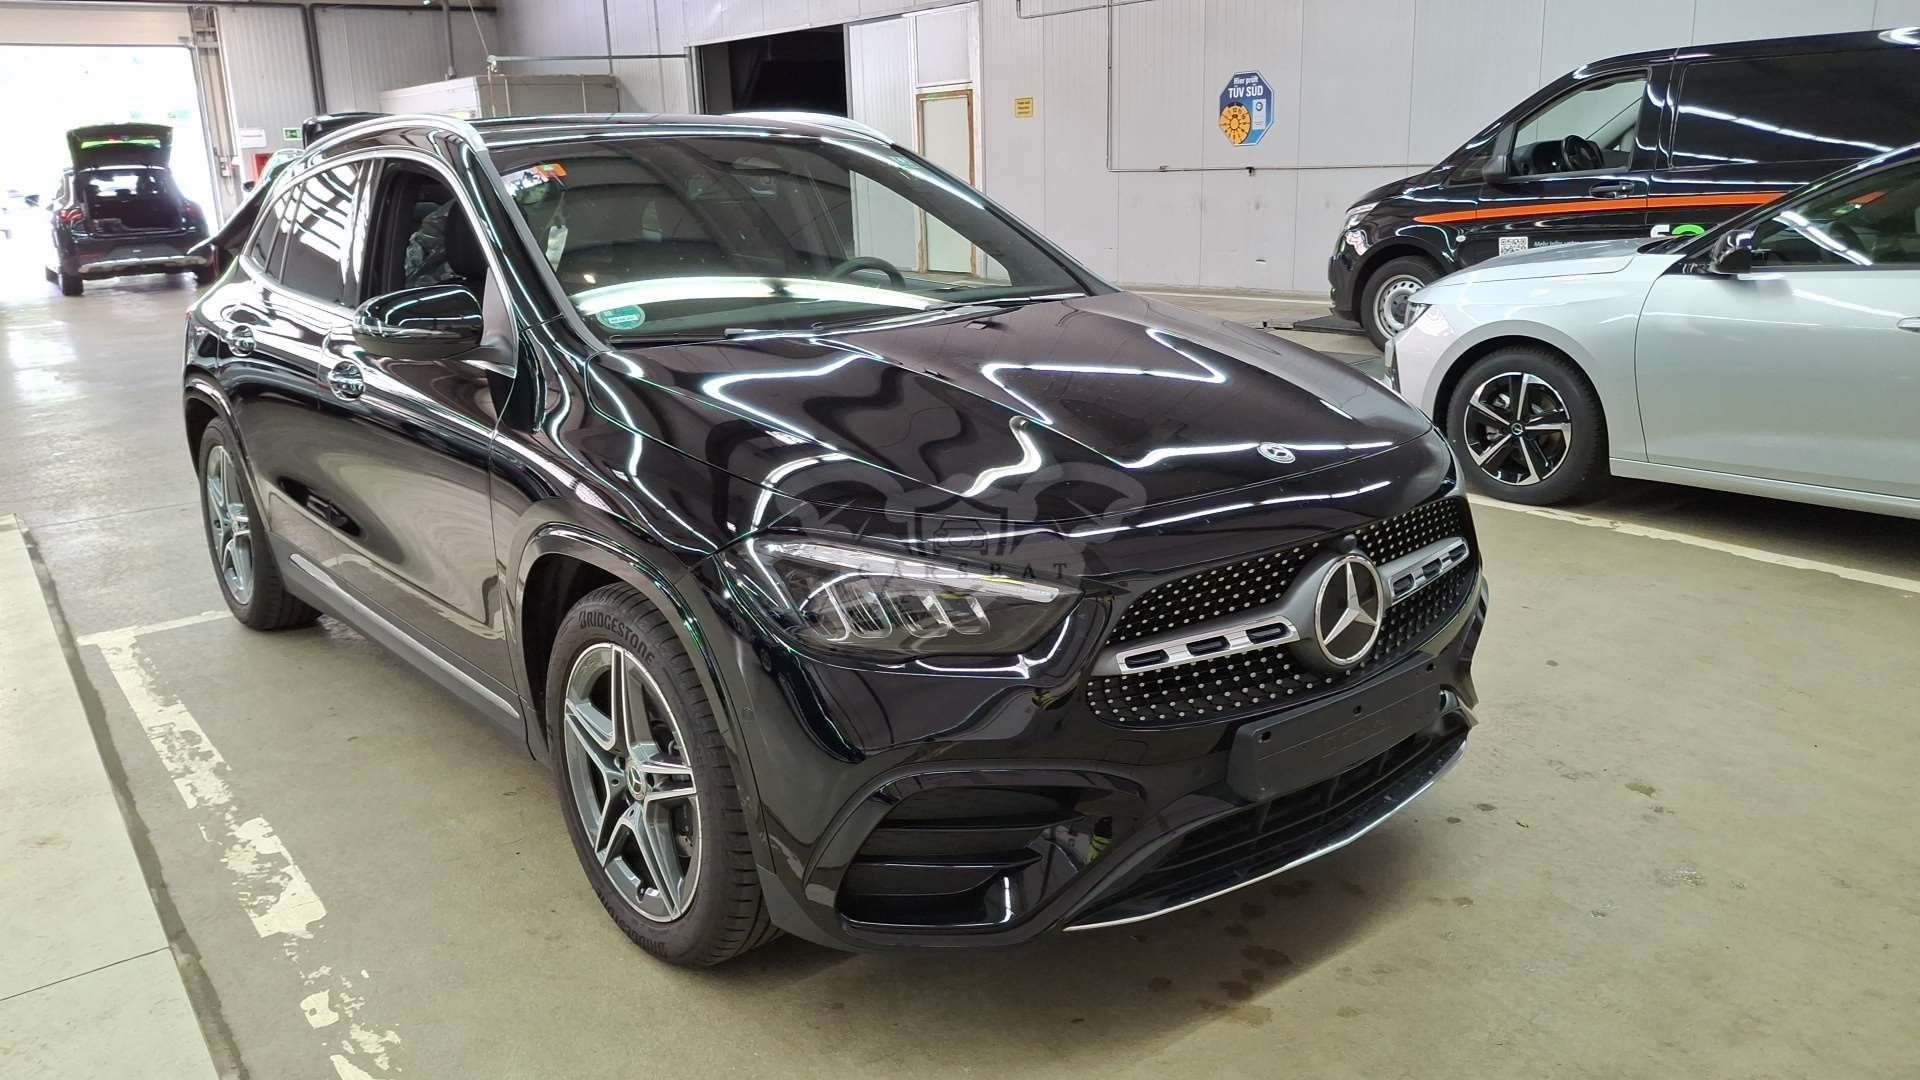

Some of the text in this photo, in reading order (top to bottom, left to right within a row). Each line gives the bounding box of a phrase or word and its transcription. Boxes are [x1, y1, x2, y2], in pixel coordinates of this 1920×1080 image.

[1233, 77, 1245, 85] Hier
[1228, 83, 1264, 99] TÜV SÜD
[579, 610, 655, 665] BRIDGESTONE
